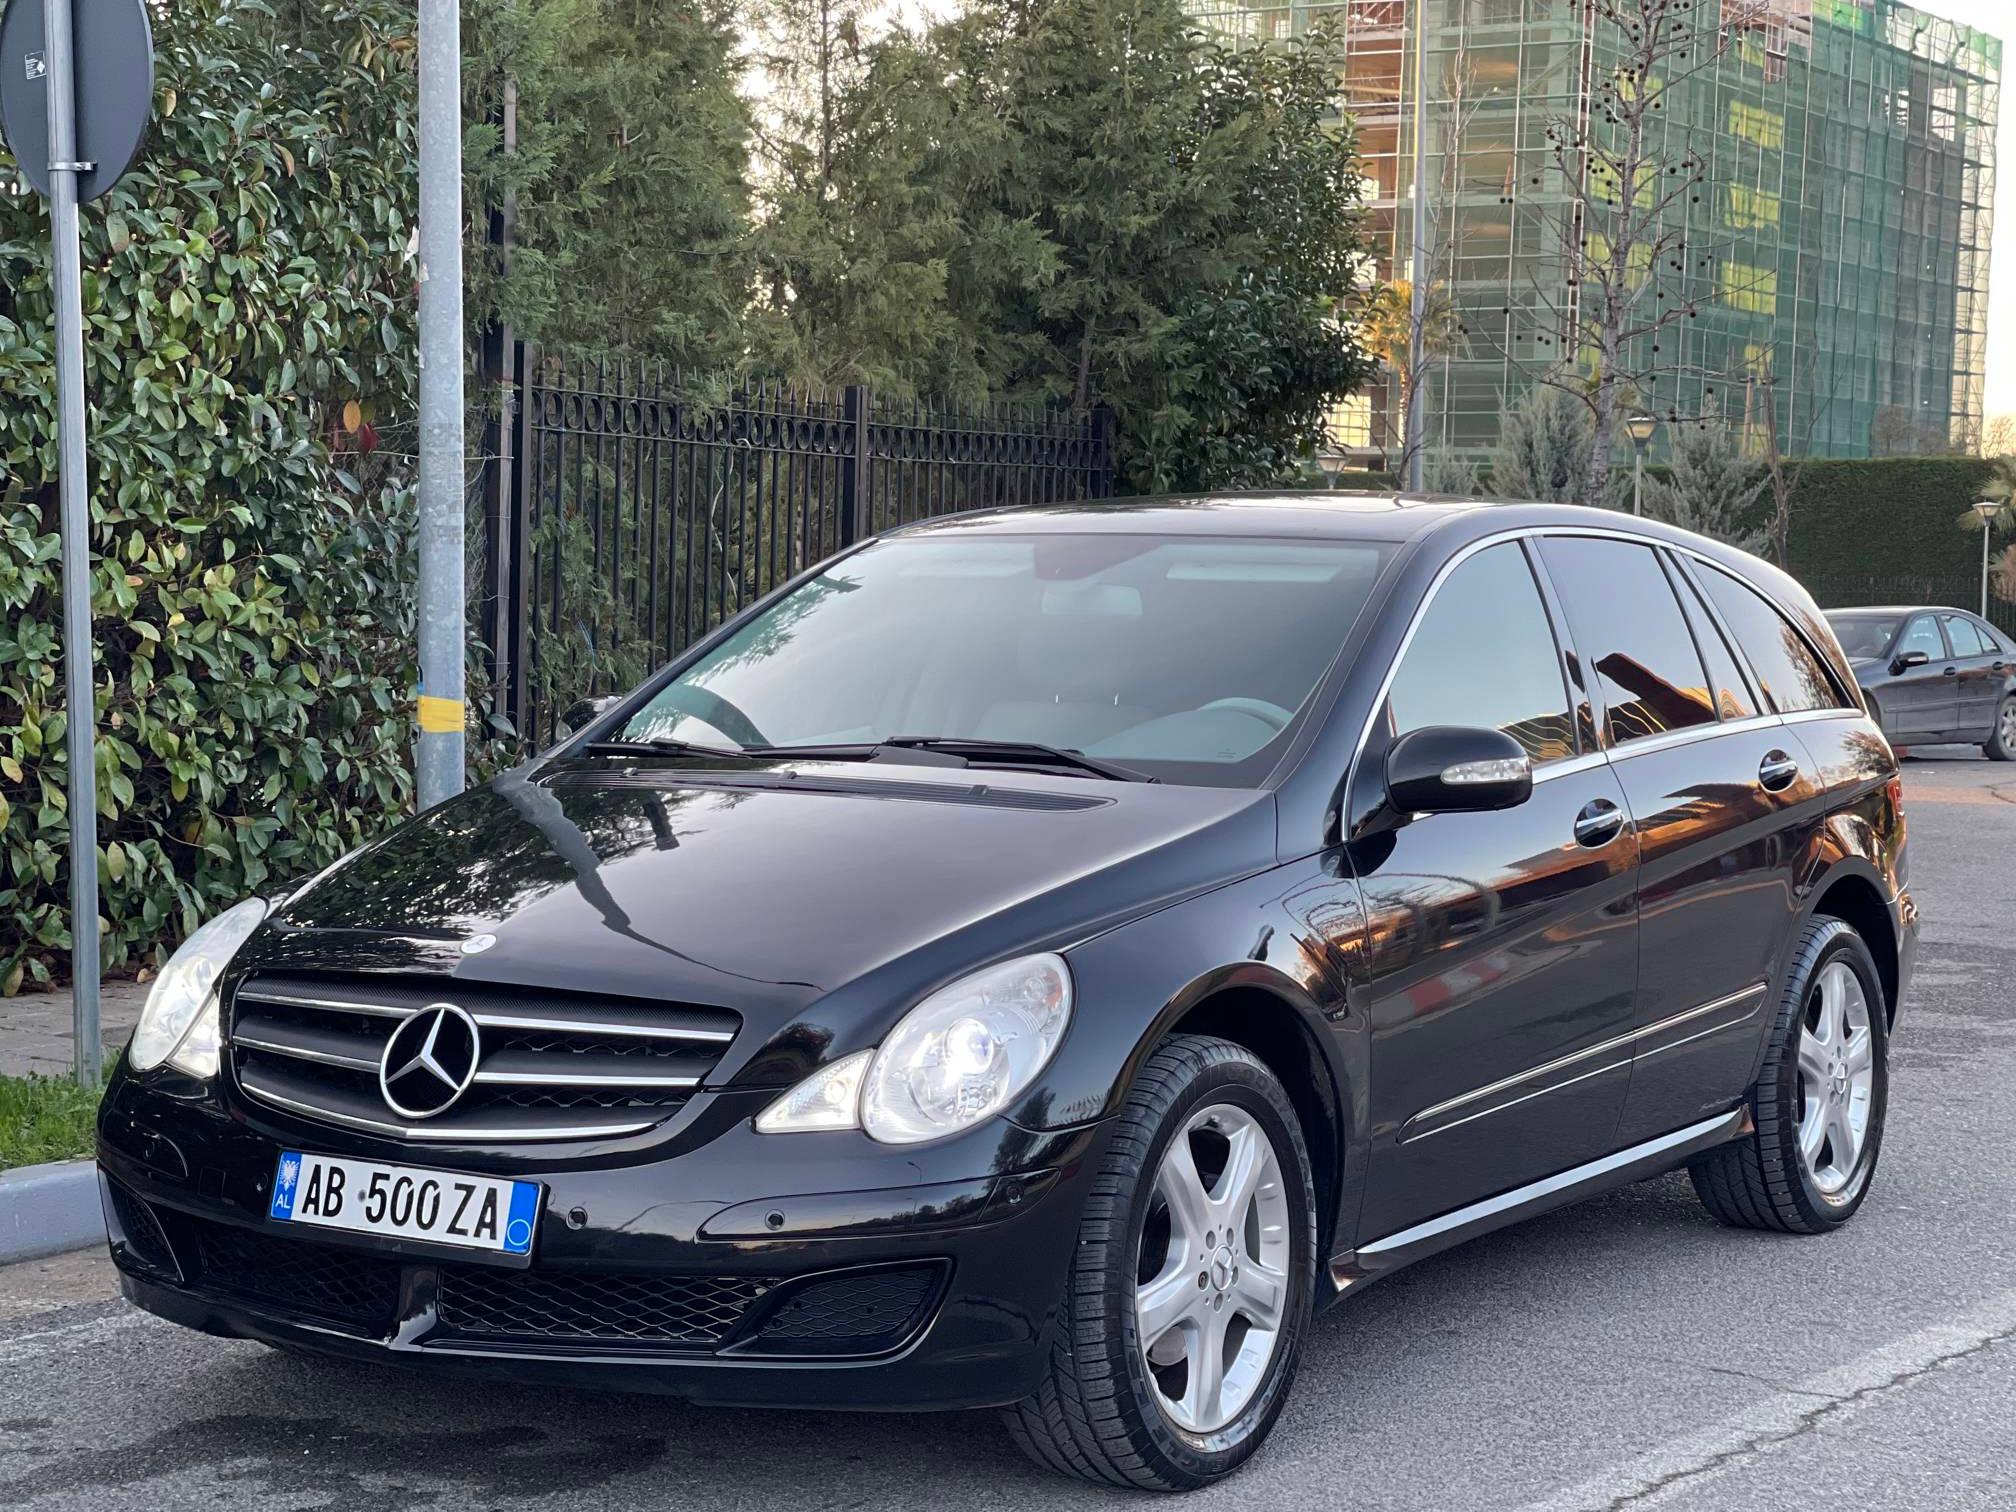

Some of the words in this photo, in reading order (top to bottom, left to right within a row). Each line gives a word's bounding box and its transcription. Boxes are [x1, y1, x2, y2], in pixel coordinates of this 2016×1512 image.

[275, 1193, 291, 1210] AL
[301, 1164, 346, 1218] AB
[365, 1171, 441, 1231] 500
[446, 1182, 498, 1241] ZA
